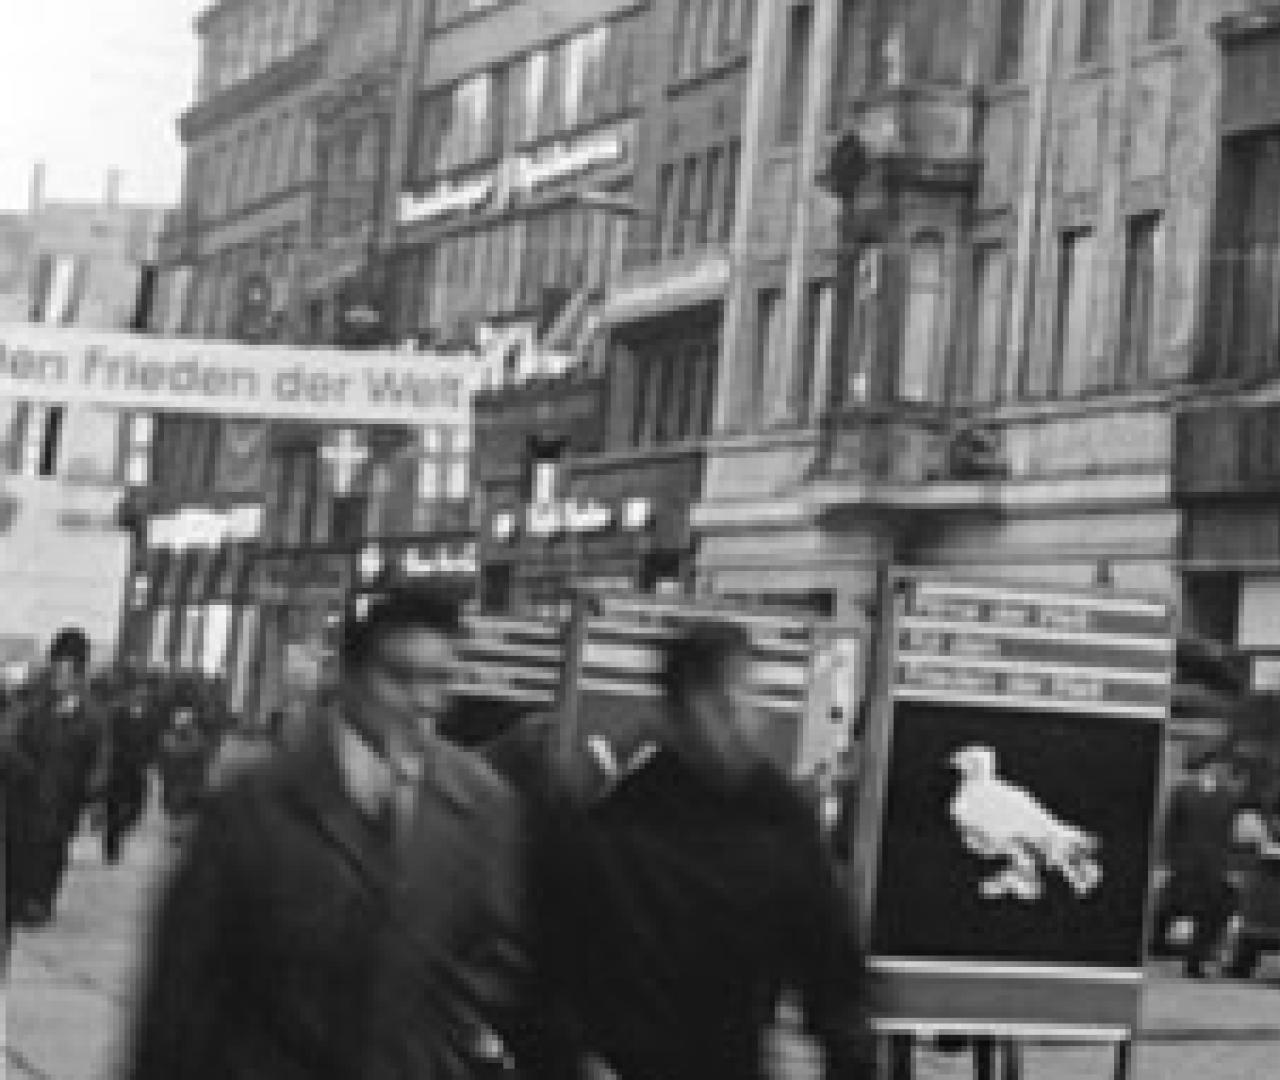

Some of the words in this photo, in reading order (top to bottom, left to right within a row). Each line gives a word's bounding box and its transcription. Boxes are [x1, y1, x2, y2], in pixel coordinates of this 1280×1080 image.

[85, 344, 259, 397] Frieden
[276, 362, 348, 403] der
[365, 366, 460, 409] Welt
